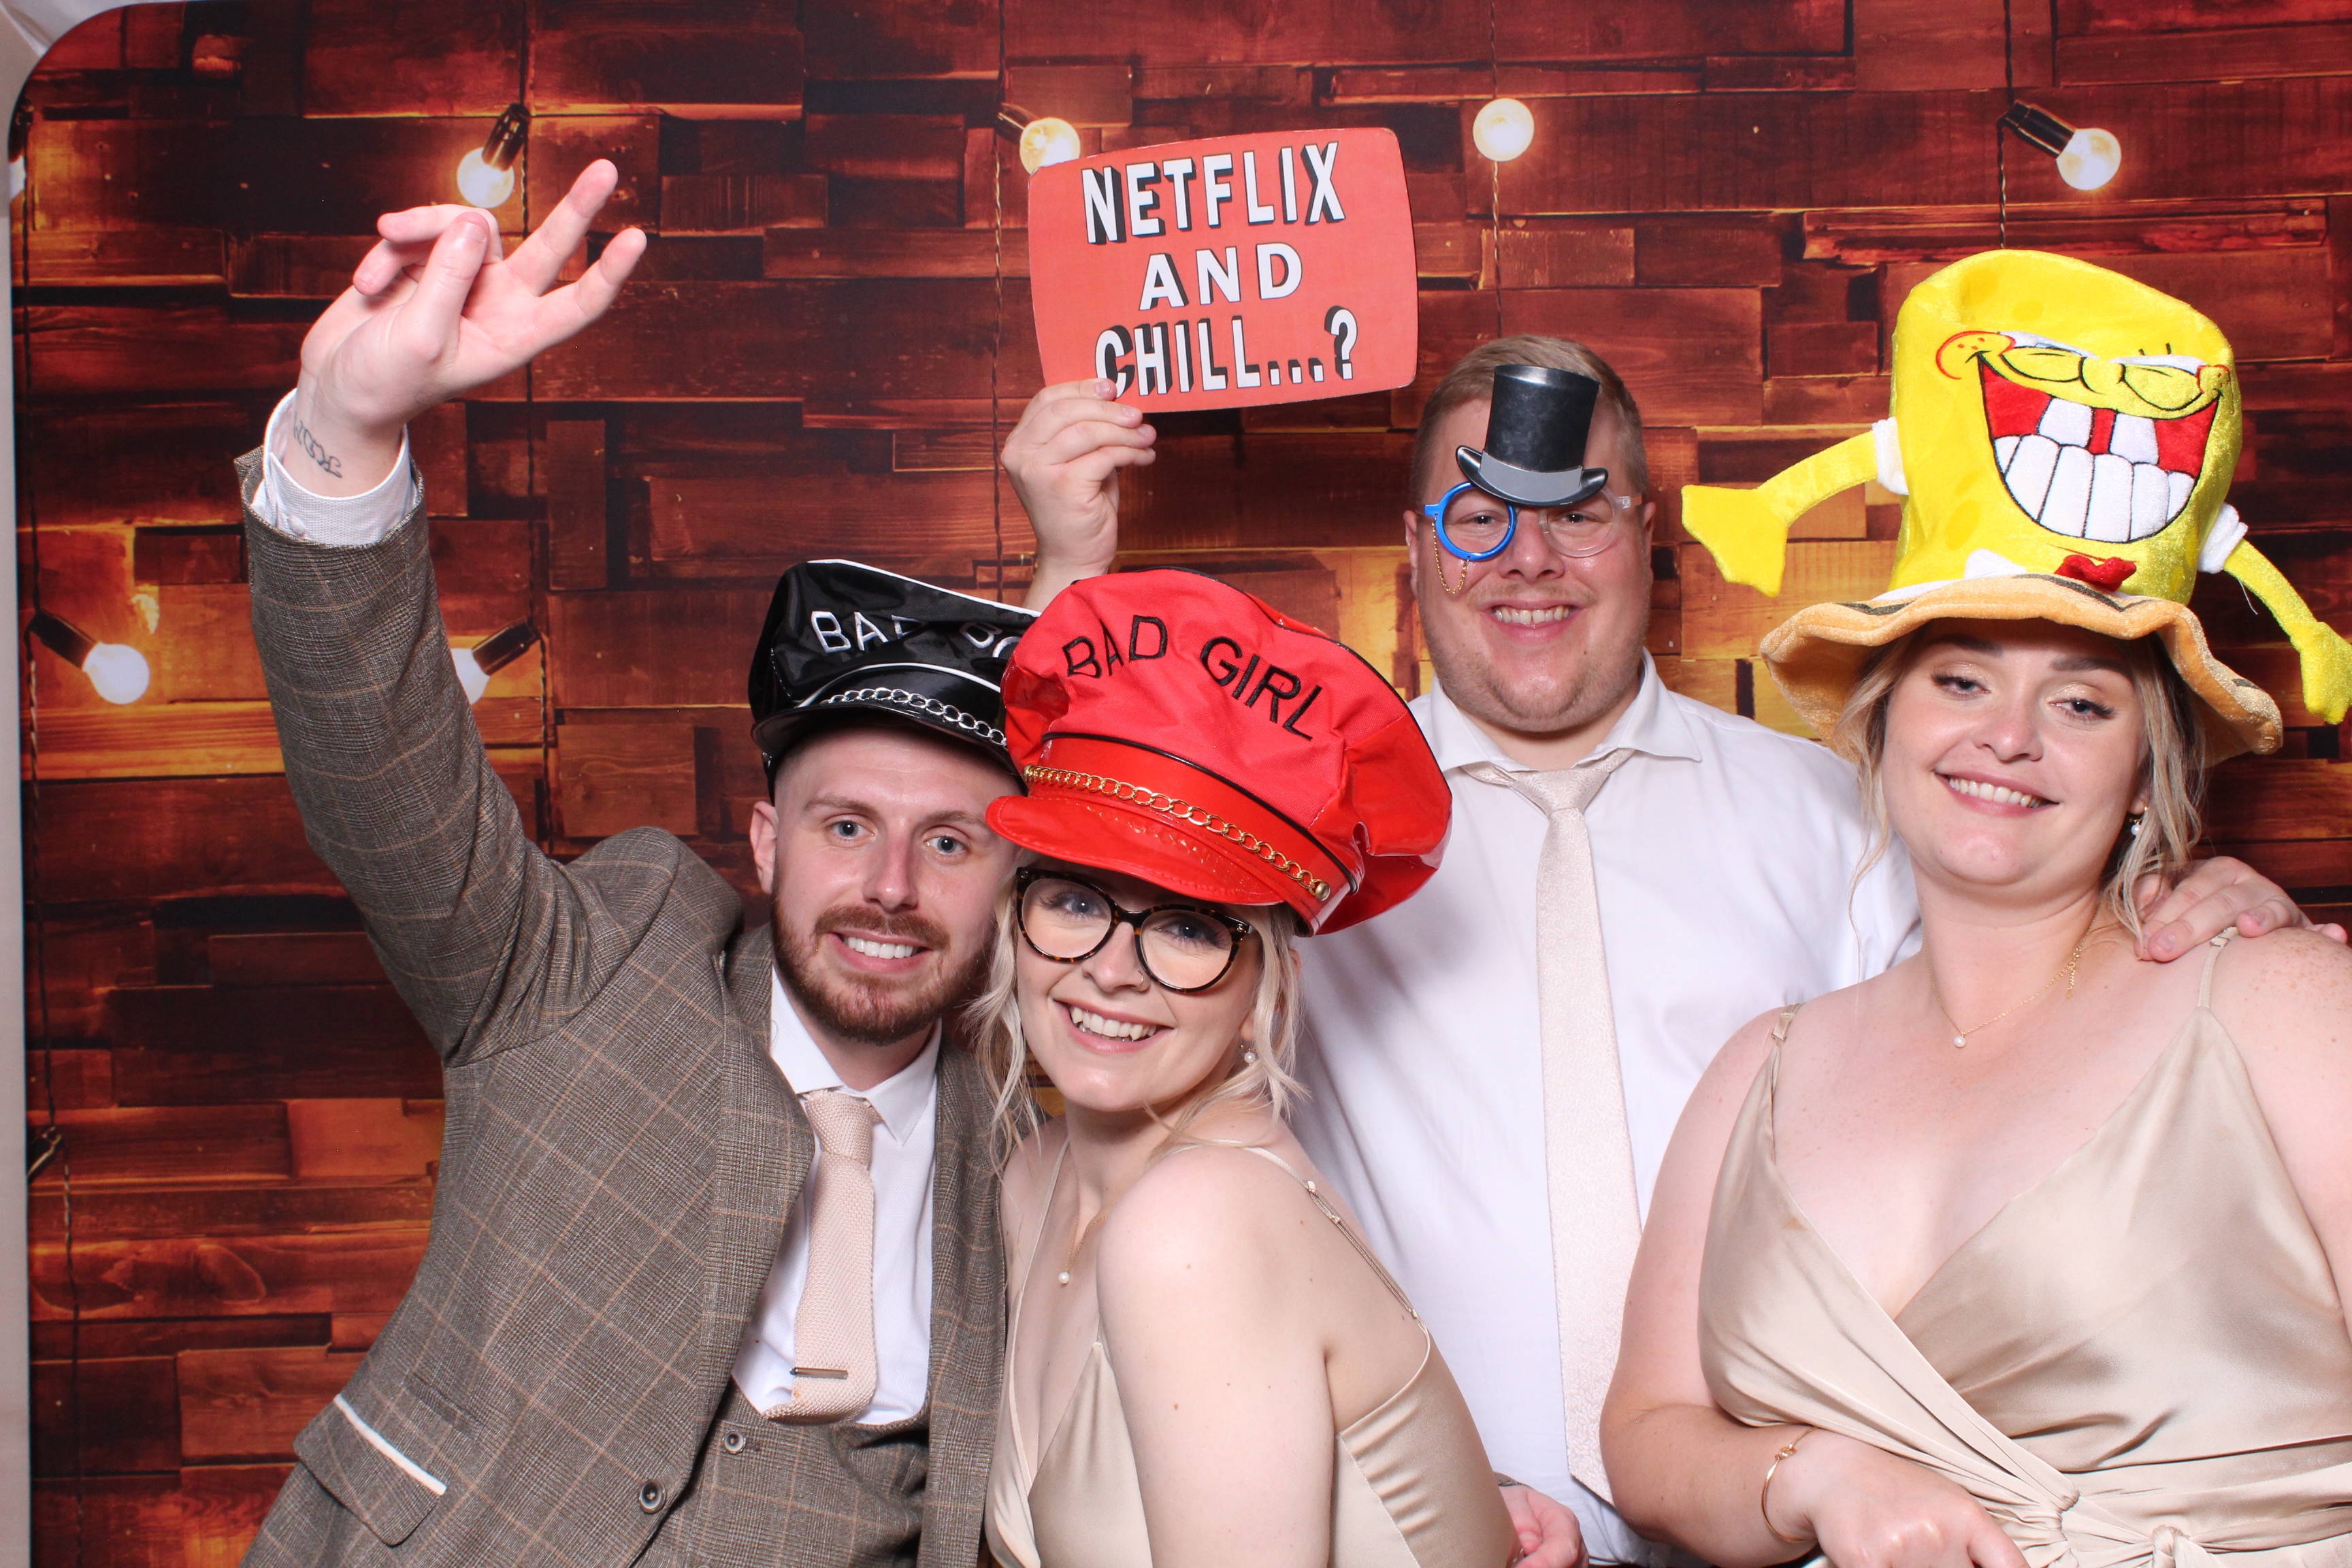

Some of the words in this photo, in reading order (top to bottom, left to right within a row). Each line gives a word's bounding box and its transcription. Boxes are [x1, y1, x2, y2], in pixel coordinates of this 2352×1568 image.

[1081, 141, 1345, 245] NETFLIX
[1139, 242, 1303, 310] AND
[1095, 306, 1358, 399] CHILL...?
[1062, 615, 1168, 679] BAD
[1199, 636, 1322, 741] GIRL
